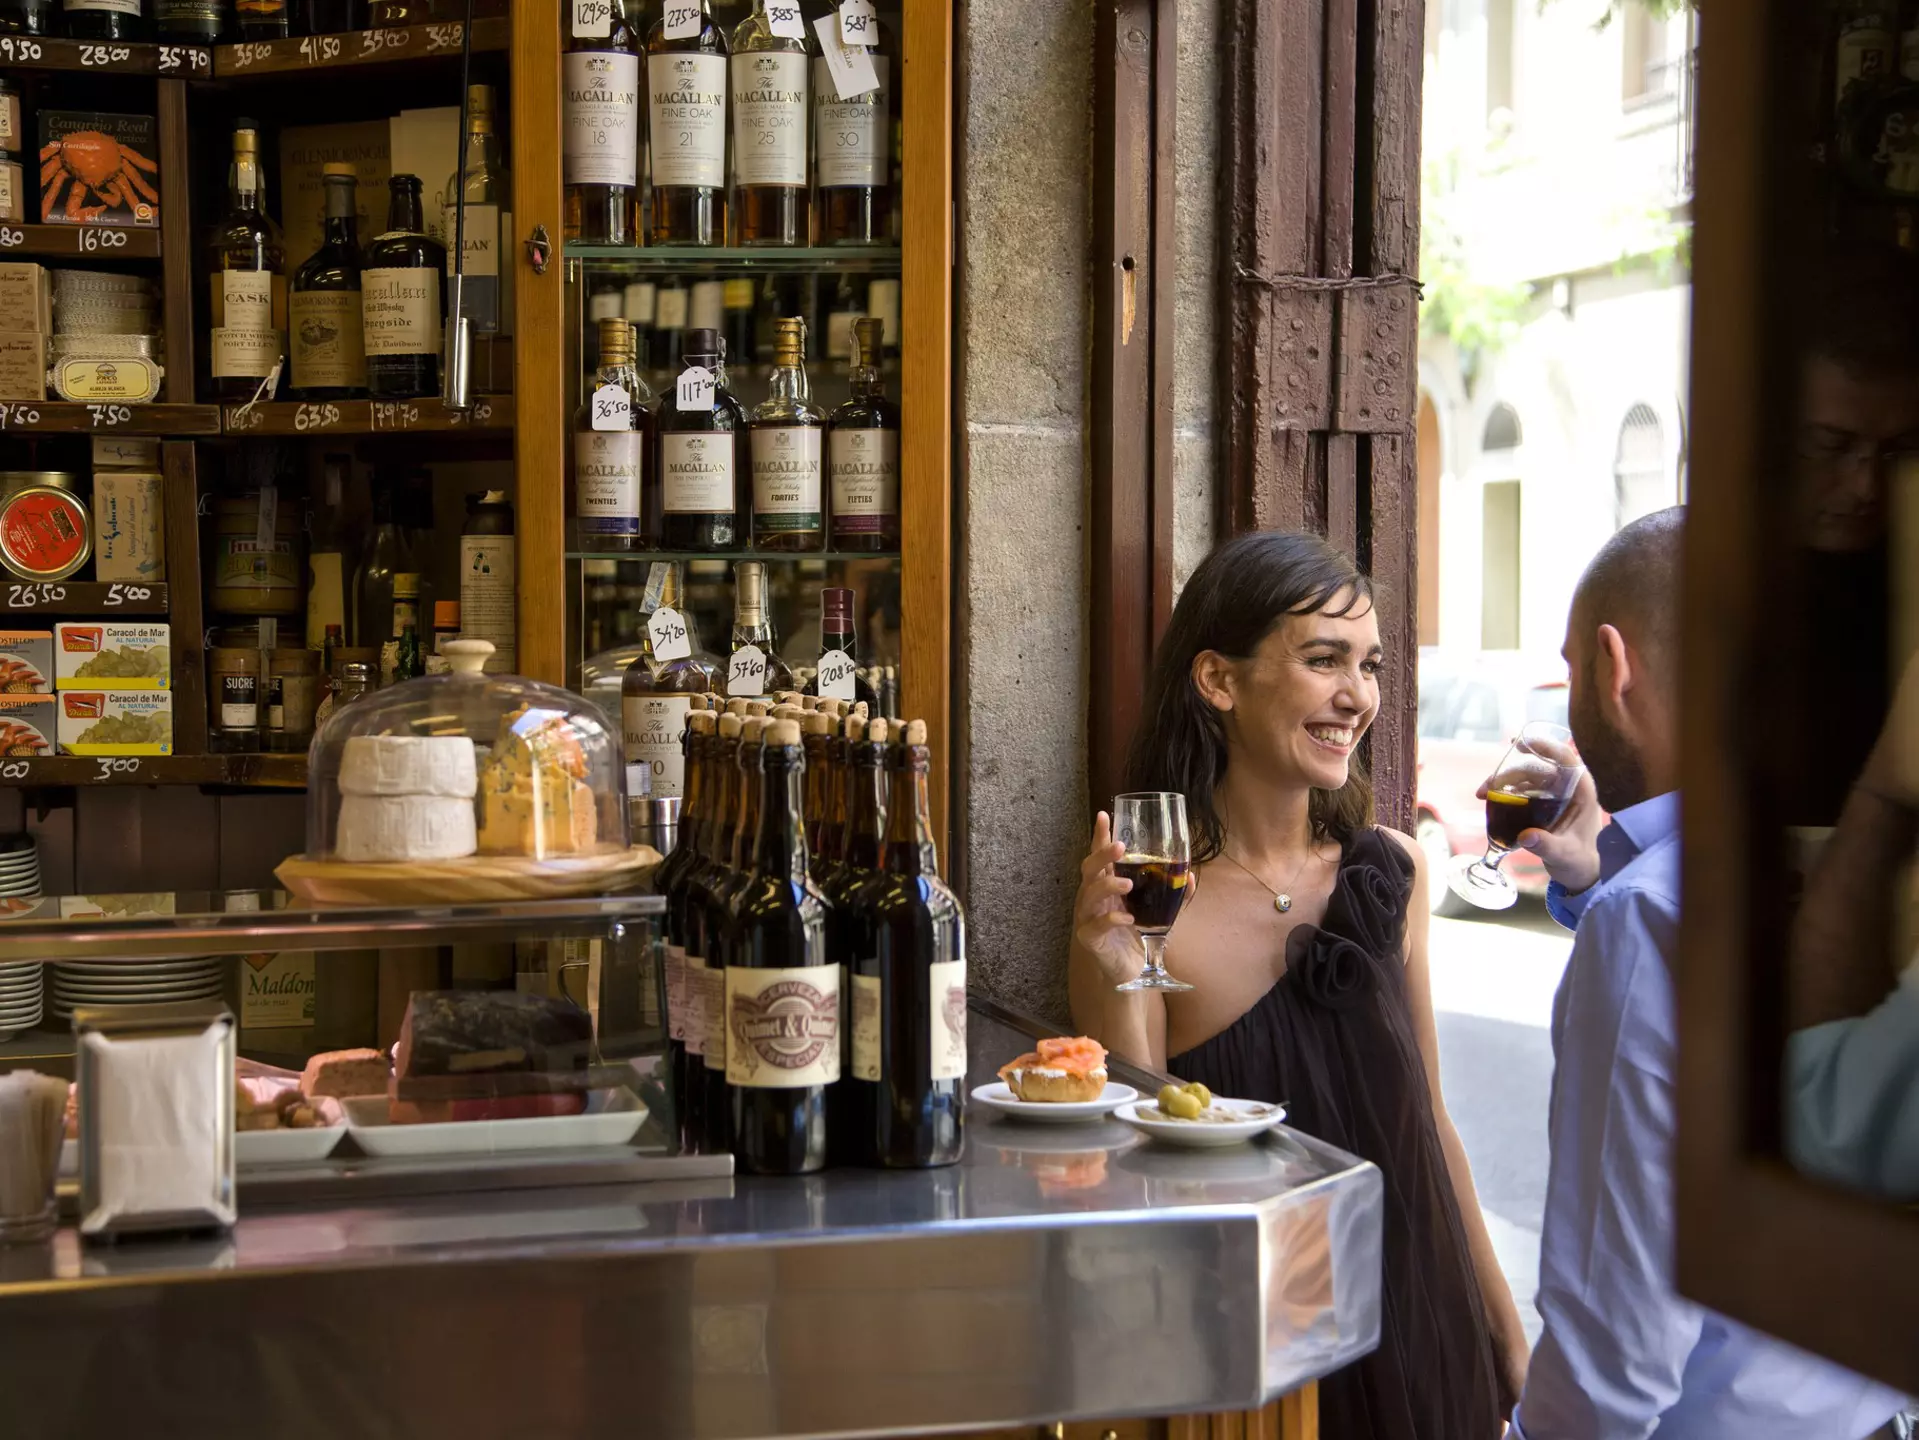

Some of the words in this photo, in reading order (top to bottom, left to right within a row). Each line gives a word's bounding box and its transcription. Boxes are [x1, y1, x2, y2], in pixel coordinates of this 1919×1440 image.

[0, 37, 42, 61] 9'50
[79, 45, 130, 65] 28'00
[589, 76, 607, 89] The
[676, 79, 695, 91] The
[756, 76, 773, 89] The
[654, 92, 722, 106] MACALLAN
[735, 90, 804, 104] MACALLAN
[661, 107, 686, 117] FINE
[689, 107, 713, 118] OAK
[824, 108, 848, 118] FINE
[850, 107, 874, 118] OAK
[117, 120, 148, 133] Real
[572, 117, 598, 128] FINE
[602, 117, 626, 128] OAK
[741, 117, 765, 128] FINE
[769, 117, 794, 128] OAK
[593, 130, 607, 144] 18
[680, 132, 693, 146] 21
[757, 131, 775, 145] 25
[836, 132, 859, 147] 30
[225, 293, 269, 304] CASK
[87, 405, 131, 427] 7'50
[595, 399, 629, 420] 36'50
[688, 453, 703, 463] The
[669, 463, 725, 473] MACALLAN
[8, 584, 66, 607] 26'50
[103, 584, 151, 606] 5'00
[106, 628, 136, 637] Caracol
[138, 628, 148, 637] de
[150, 628, 165, 637] Mar
[226, 677, 254, 689] SUCRE
[109, 694, 138, 702] Caracol
[140, 694, 150, 702] de
[152, 694, 167, 702] Mar
[646, 719, 664, 731] The
[248, 972, 314, 996] Maldon
[760, 982, 821, 1003] CERVEZA
[785, 1013, 797, 1038] &
[757, 1042, 822, 1068] ESPECIAL
